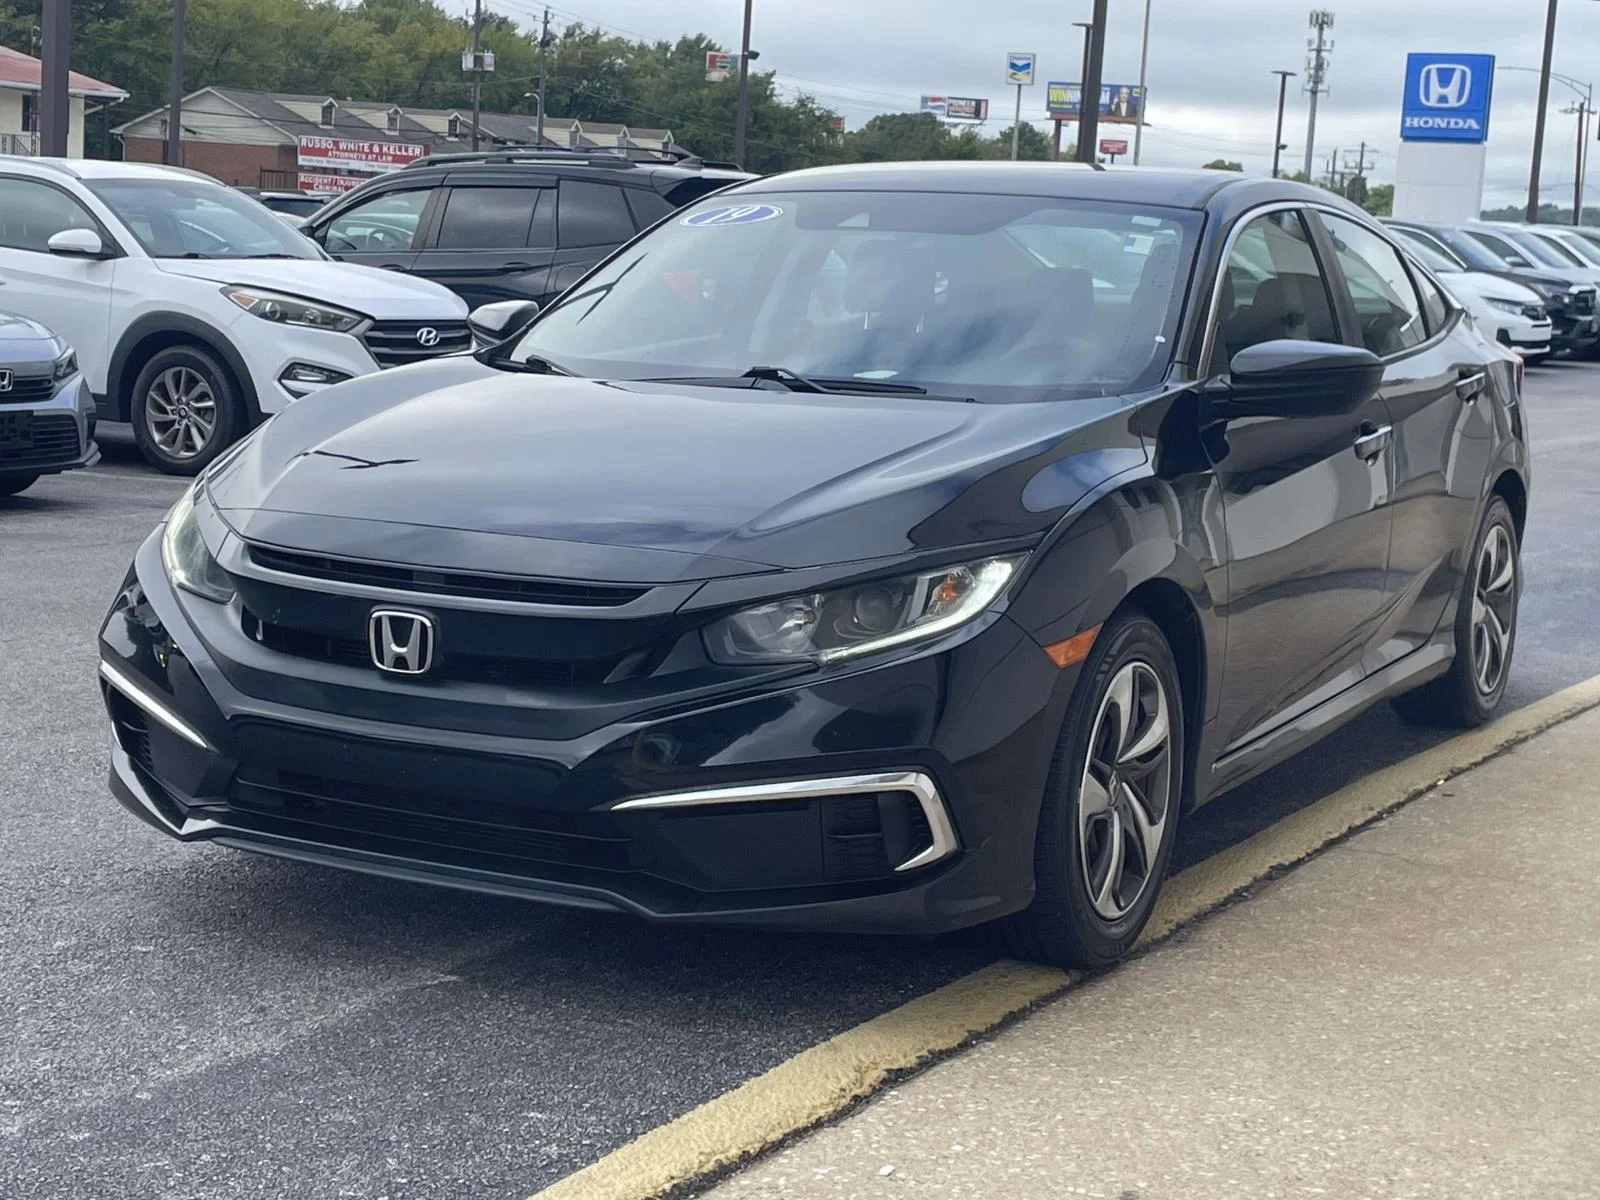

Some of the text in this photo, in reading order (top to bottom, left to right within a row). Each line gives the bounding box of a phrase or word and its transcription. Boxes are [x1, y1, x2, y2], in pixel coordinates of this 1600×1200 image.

[1405, 117, 1480, 130] HONDA
[338, 141, 370, 153] WHITE
[372, 144, 380, 153] &
[383, 144, 421, 157] KELLER
[327, 151, 366, 161] ATTORNEYS
[377, 155, 393, 163] LAW
[299, 174, 332, 185] ACCIDENT
[313, 183, 346, 193] CRIMINAL
